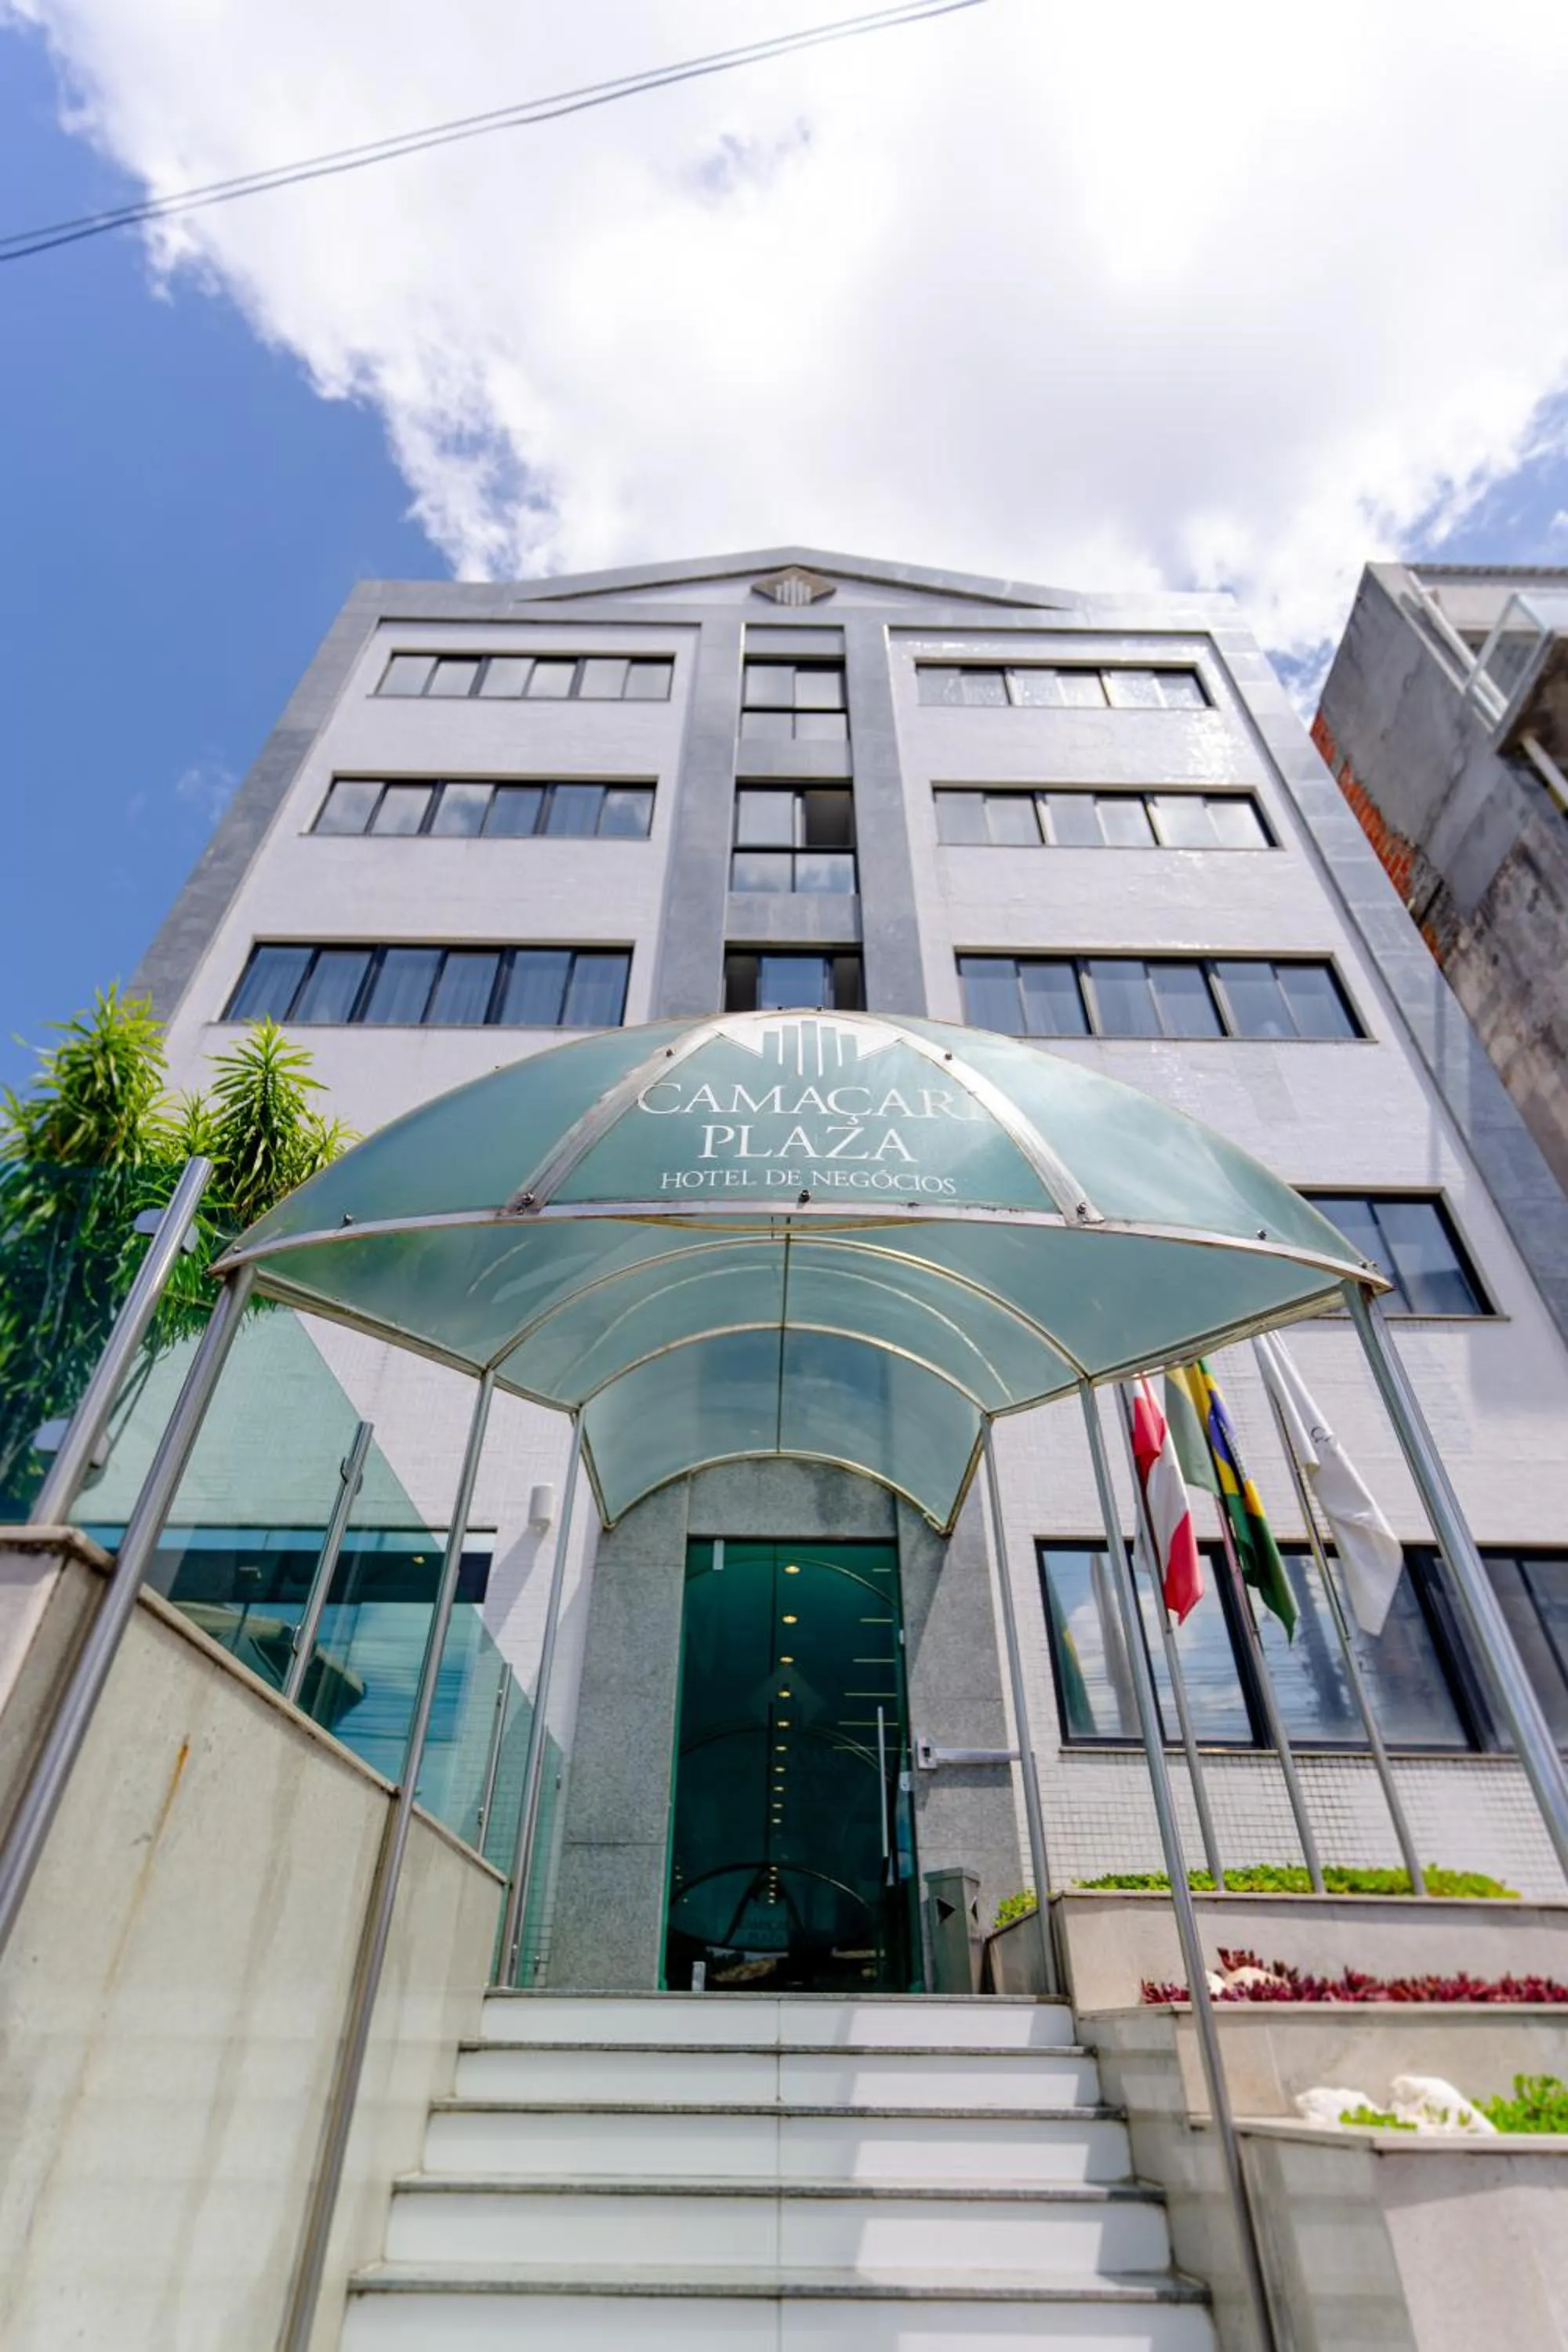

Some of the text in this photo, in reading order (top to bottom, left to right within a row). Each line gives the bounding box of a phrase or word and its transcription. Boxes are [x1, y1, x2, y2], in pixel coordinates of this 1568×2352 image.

[698, 1125, 919, 1162] PLAZA
[660, 1169, 956, 1194] HOTEL DE NEGÓCIOS
